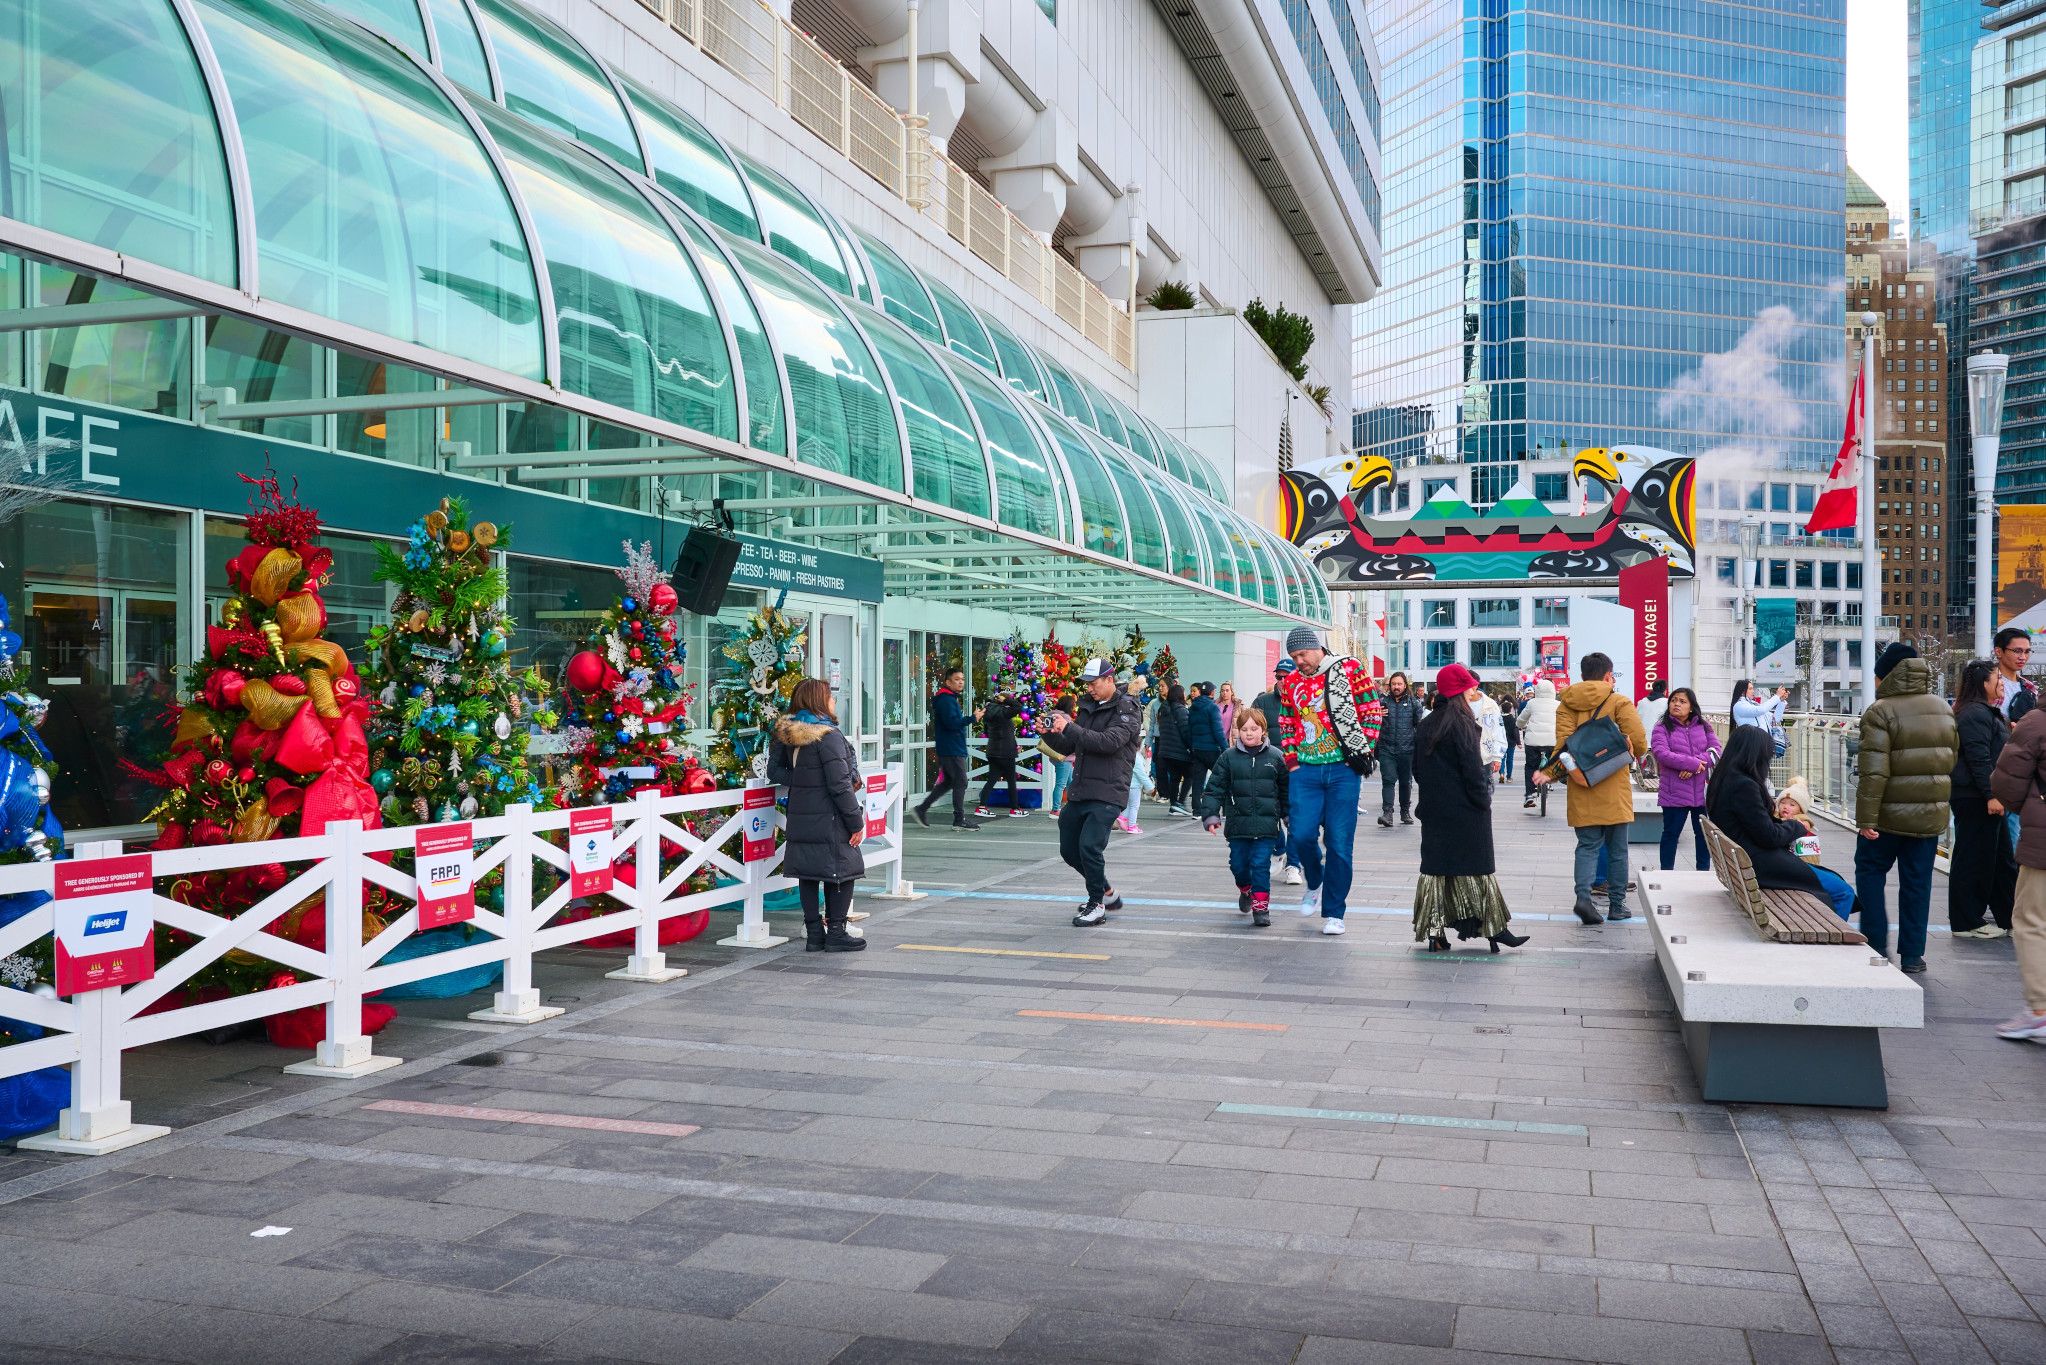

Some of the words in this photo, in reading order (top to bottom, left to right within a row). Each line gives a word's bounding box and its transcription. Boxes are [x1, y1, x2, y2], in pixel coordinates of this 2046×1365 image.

[760, 546, 774, 560] TEA
[779, 550, 797, 564] BEER
[801, 554, 818, 568] WINE
[769, 567, 791, 582] PANINI
[796, 572, 816, 586] FRESH
[817, 575, 845, 590] PASTRIES
[1645, 599, 1657, 657] VOYAGE!
[64, 879, 78, 887] TREE
[78, 875, 109, 885] GENEROUSLY
[109, 872, 137, 881] SPONSORED
[431, 865, 461, 880] FRPD
